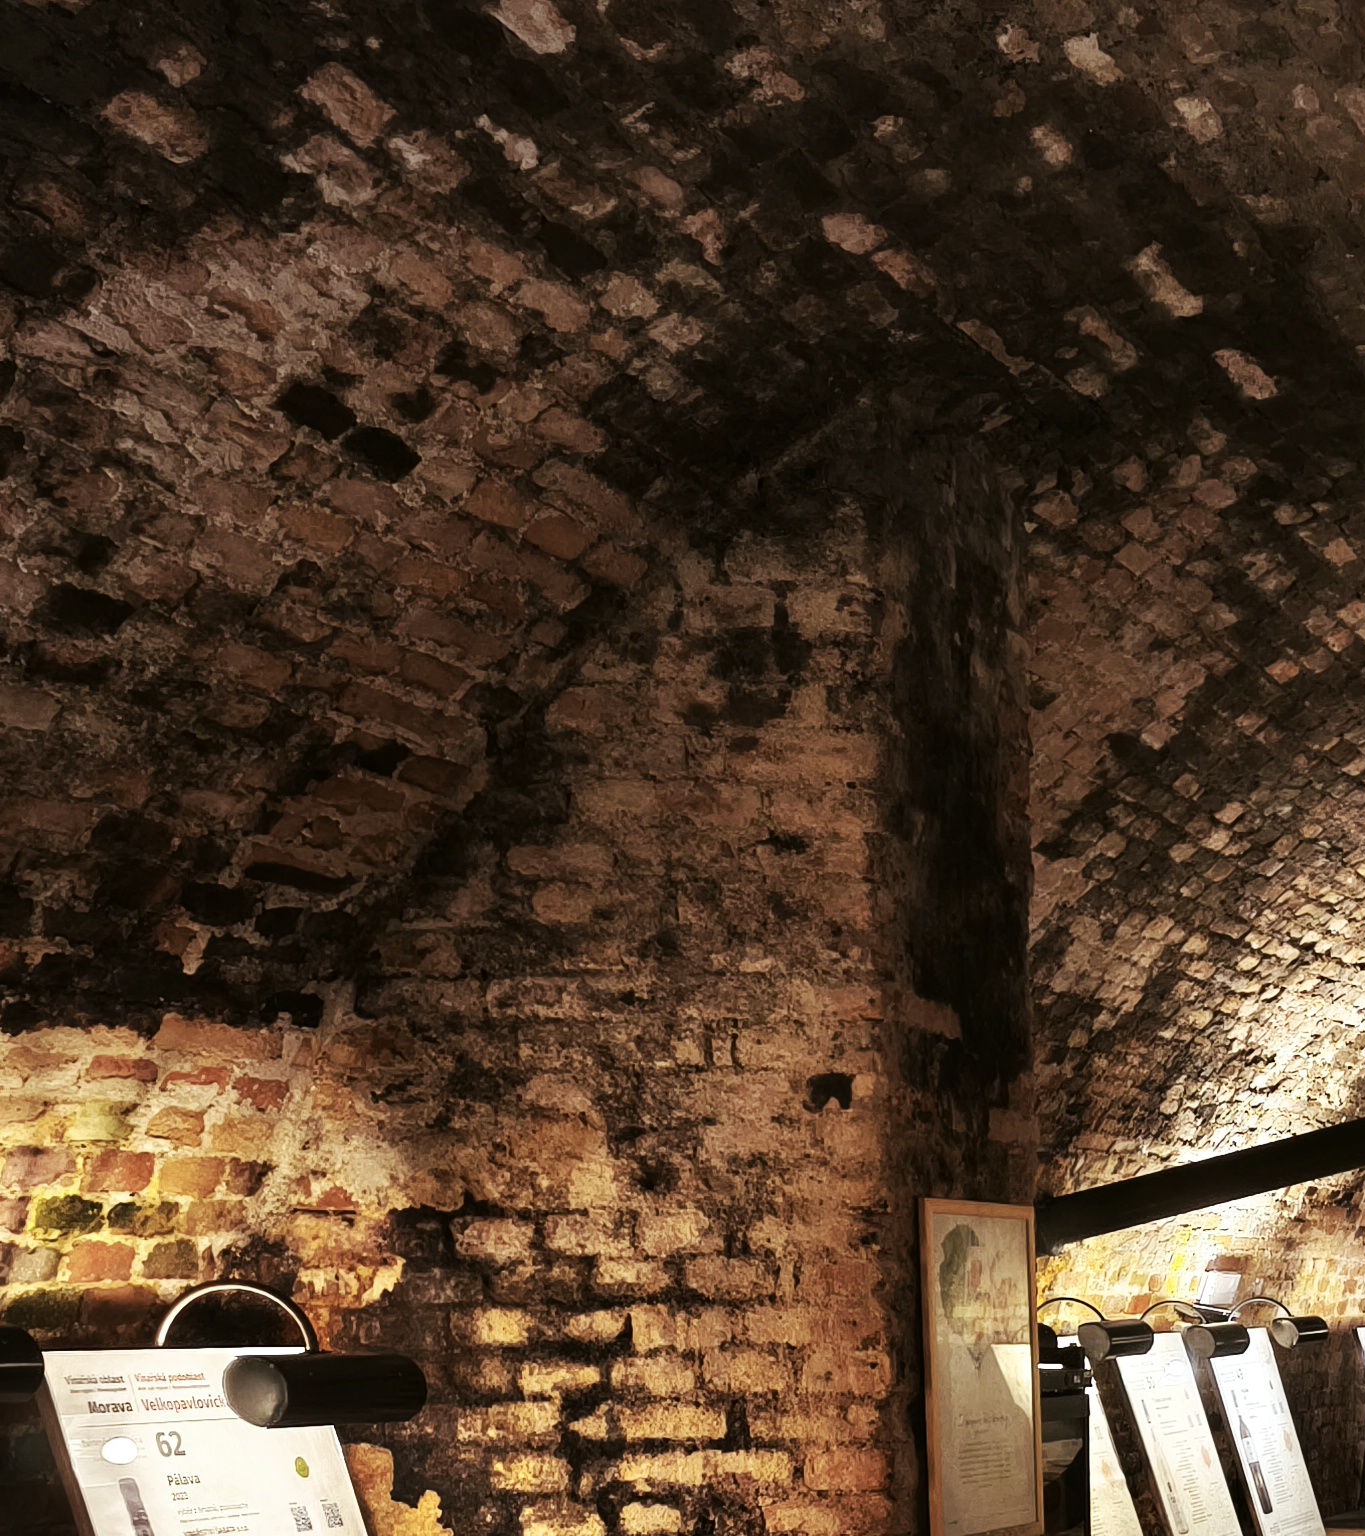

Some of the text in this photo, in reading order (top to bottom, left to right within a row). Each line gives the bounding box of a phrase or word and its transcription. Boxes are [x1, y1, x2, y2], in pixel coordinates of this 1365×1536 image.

[87, 1401, 133, 1414] Morava
[141, 1394, 228, 1413] Velkopavlovick
[155, 1430, 187, 1458] 62
[167, 1473, 201, 1486] Pálava
